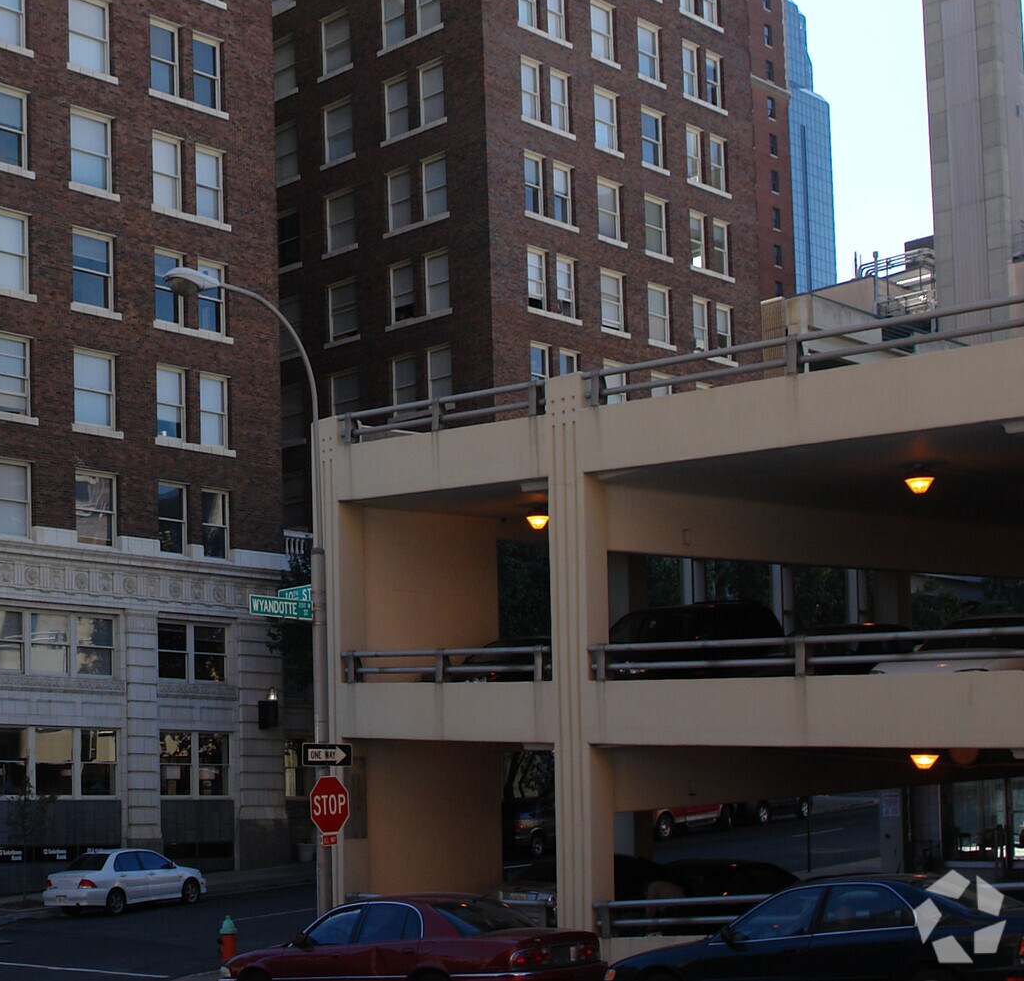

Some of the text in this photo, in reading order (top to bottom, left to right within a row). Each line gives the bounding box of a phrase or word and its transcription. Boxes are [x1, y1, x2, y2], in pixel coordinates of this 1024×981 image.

[302, 588, 312, 601] ST
[252, 598, 298, 615] WYANDOTTE
[310, 750, 337, 759] ONE WAY
[313, 794, 346, 816] STOP
